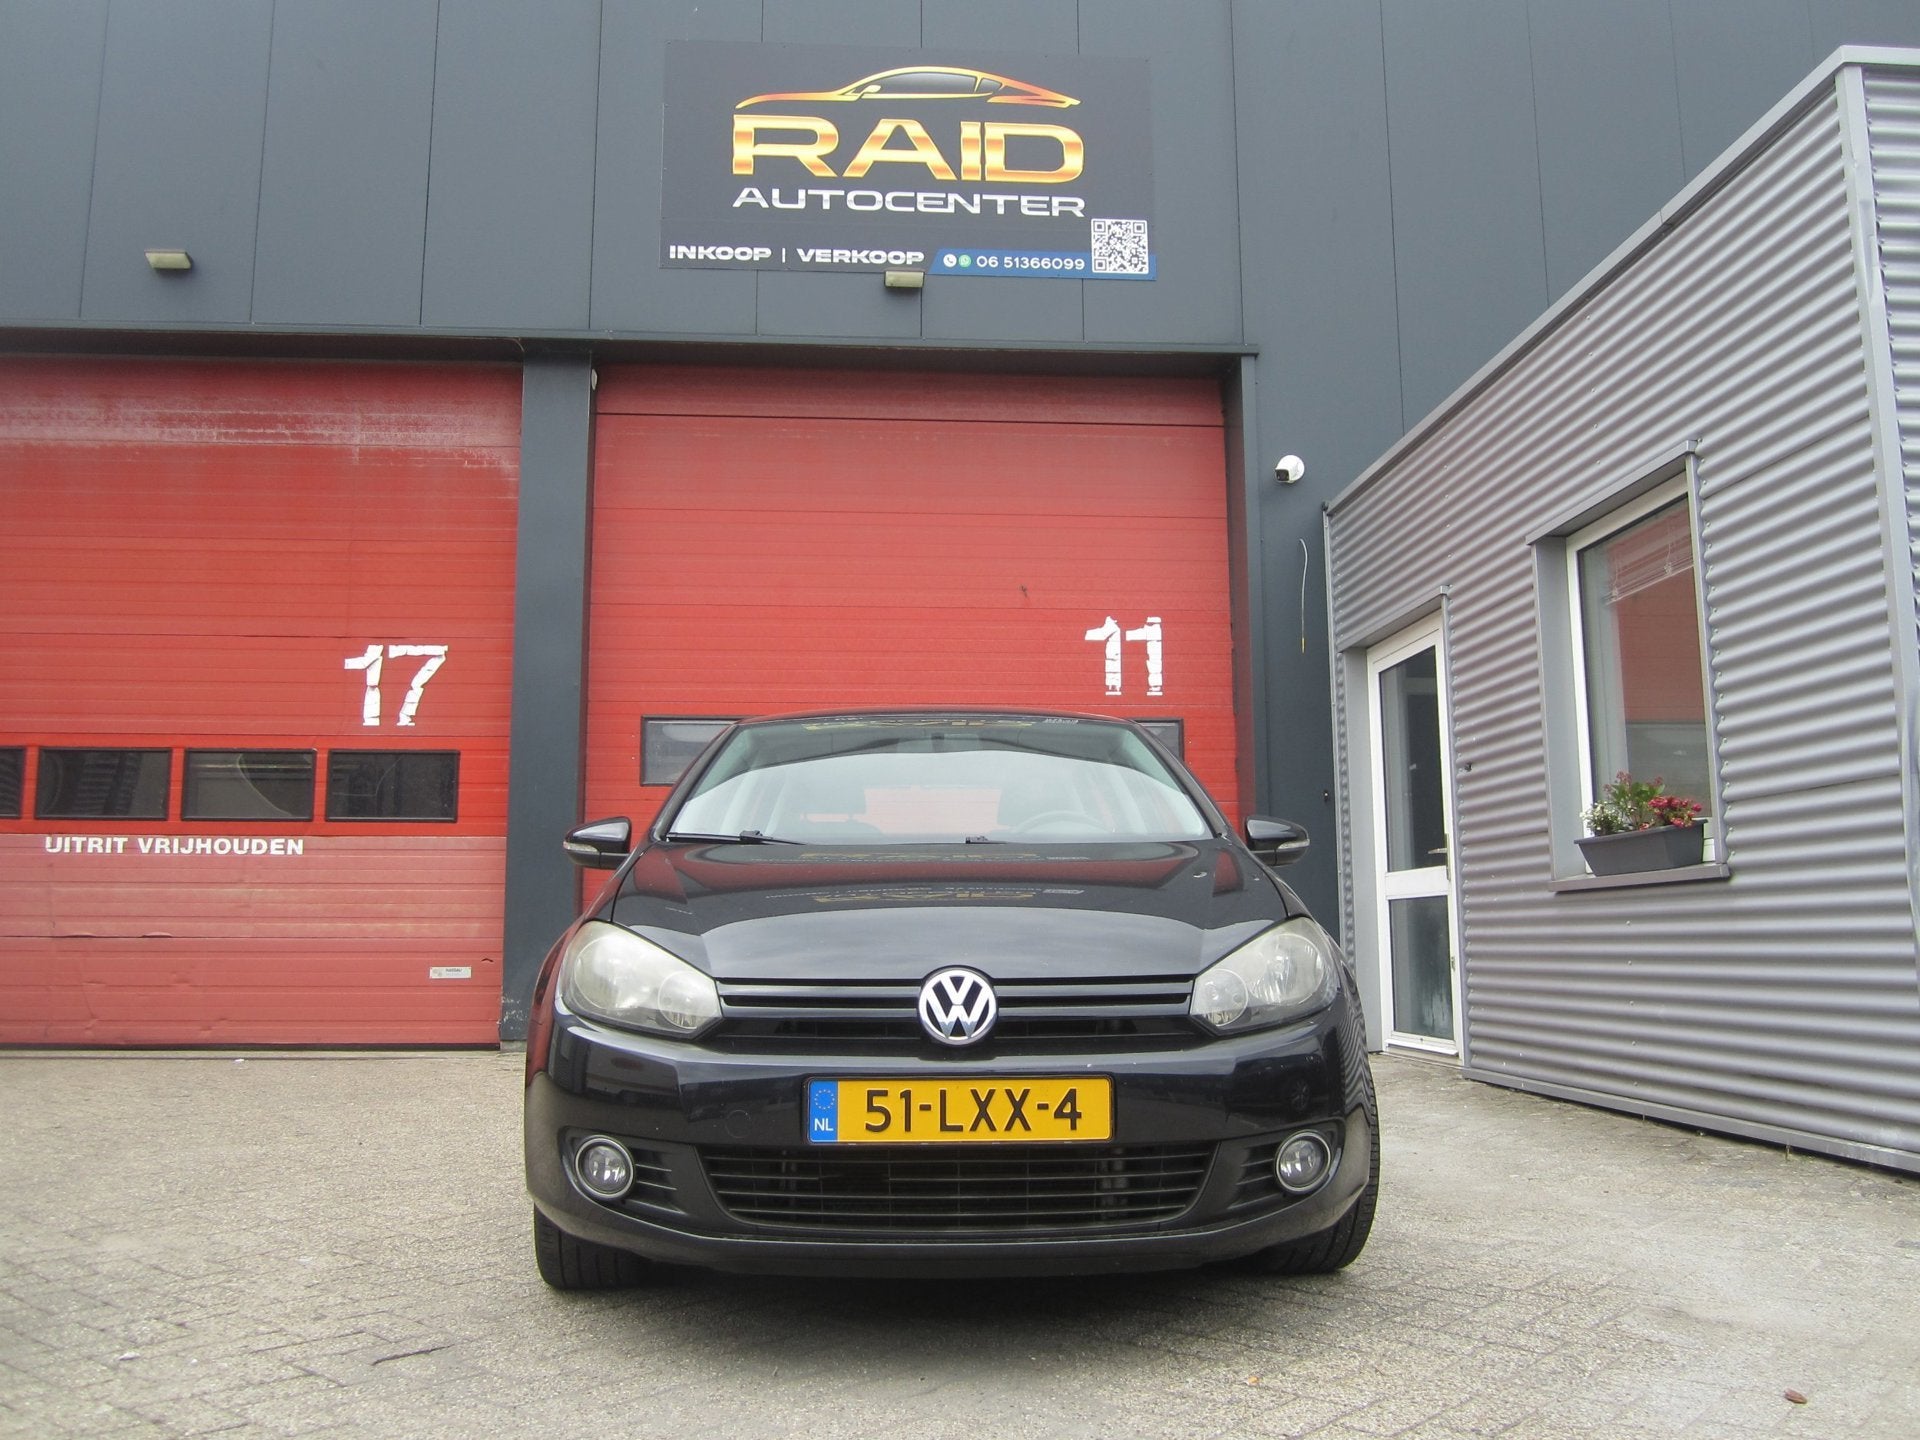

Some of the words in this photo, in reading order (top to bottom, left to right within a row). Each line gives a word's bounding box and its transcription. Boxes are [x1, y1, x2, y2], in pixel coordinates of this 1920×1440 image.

[732, 114, 1085, 183] RAID
[732, 187, 1086, 217] AUTOCENTER
[669, 245, 772, 261] INKOOP
[796, 248, 925, 265] VERKOOP
[976, 255, 999, 268] 06
[1003, 256, 1085, 270] 51366099
[1085, 616, 1163, 695] 11
[344, 644, 449, 726] 17
[45, 836, 128, 854] UITRIT
[137, 837, 304, 855] VRIJHOUDEN
[814, 1118, 834, 1132] NL
[865, 1088, 1082, 1133] 51-LXX-4
